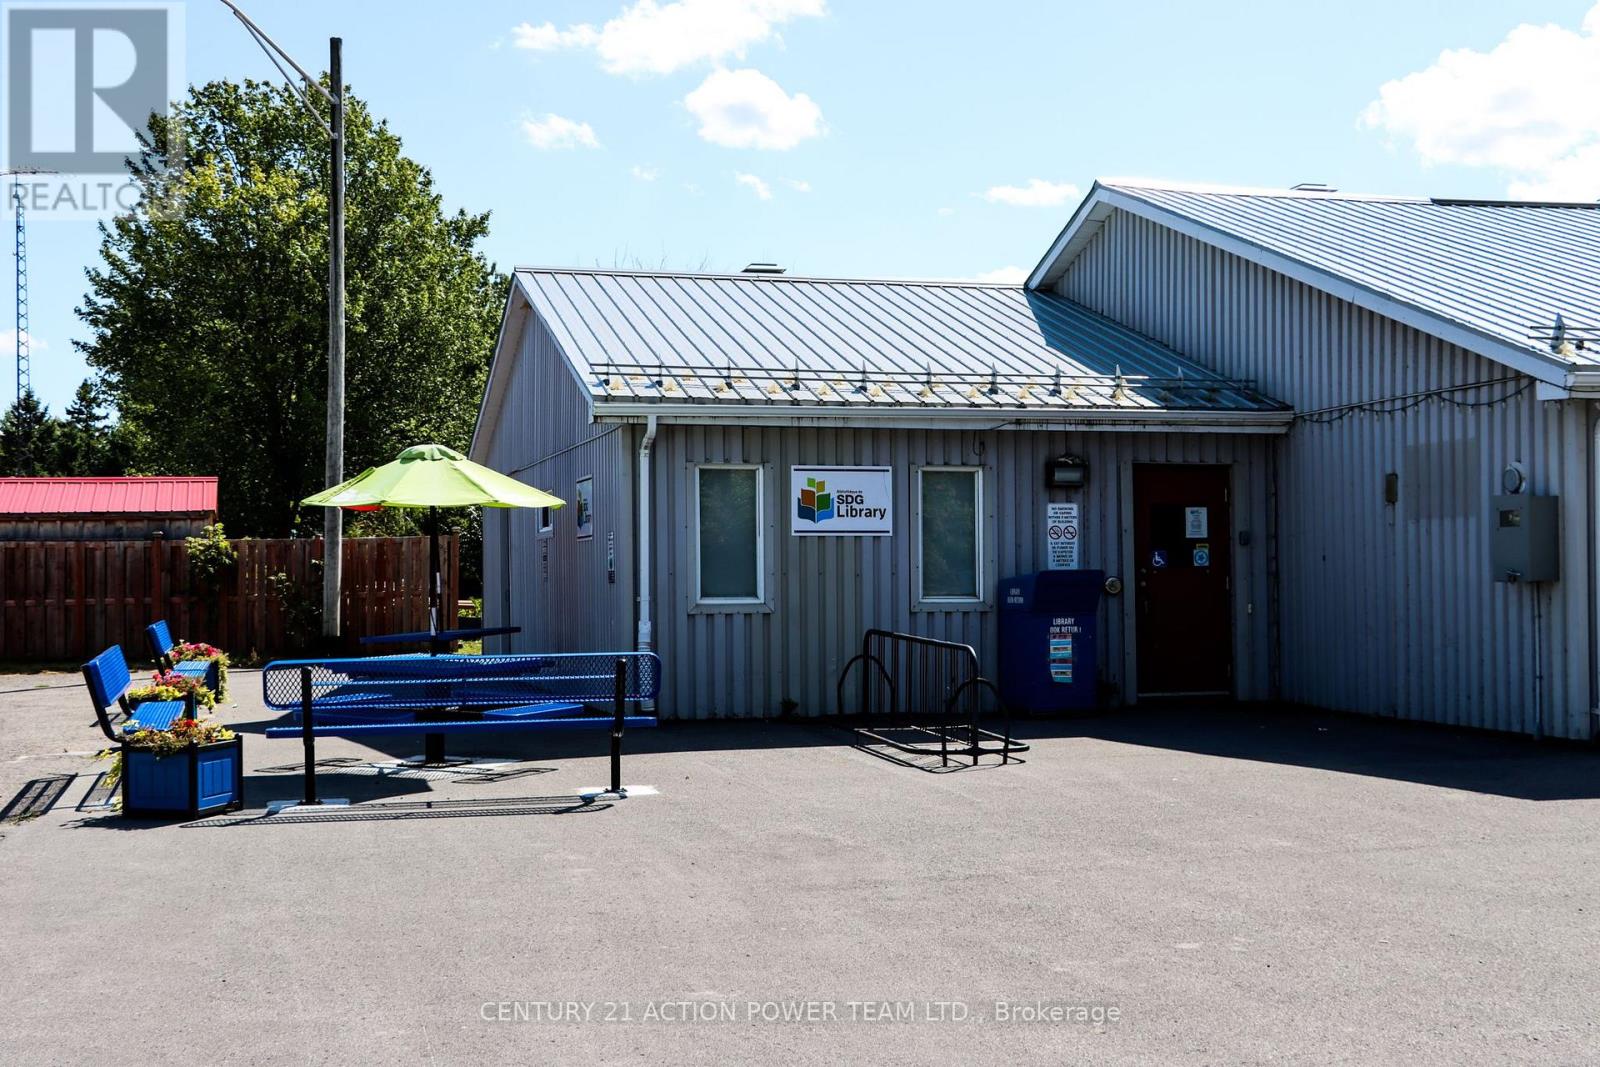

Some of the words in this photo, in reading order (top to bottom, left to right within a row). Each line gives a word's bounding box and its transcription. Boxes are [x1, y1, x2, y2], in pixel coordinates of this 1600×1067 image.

[836, 494, 864, 504] SDG
[836, 505, 886, 520] Library
[1052, 618, 1074, 626] LIBRARY
